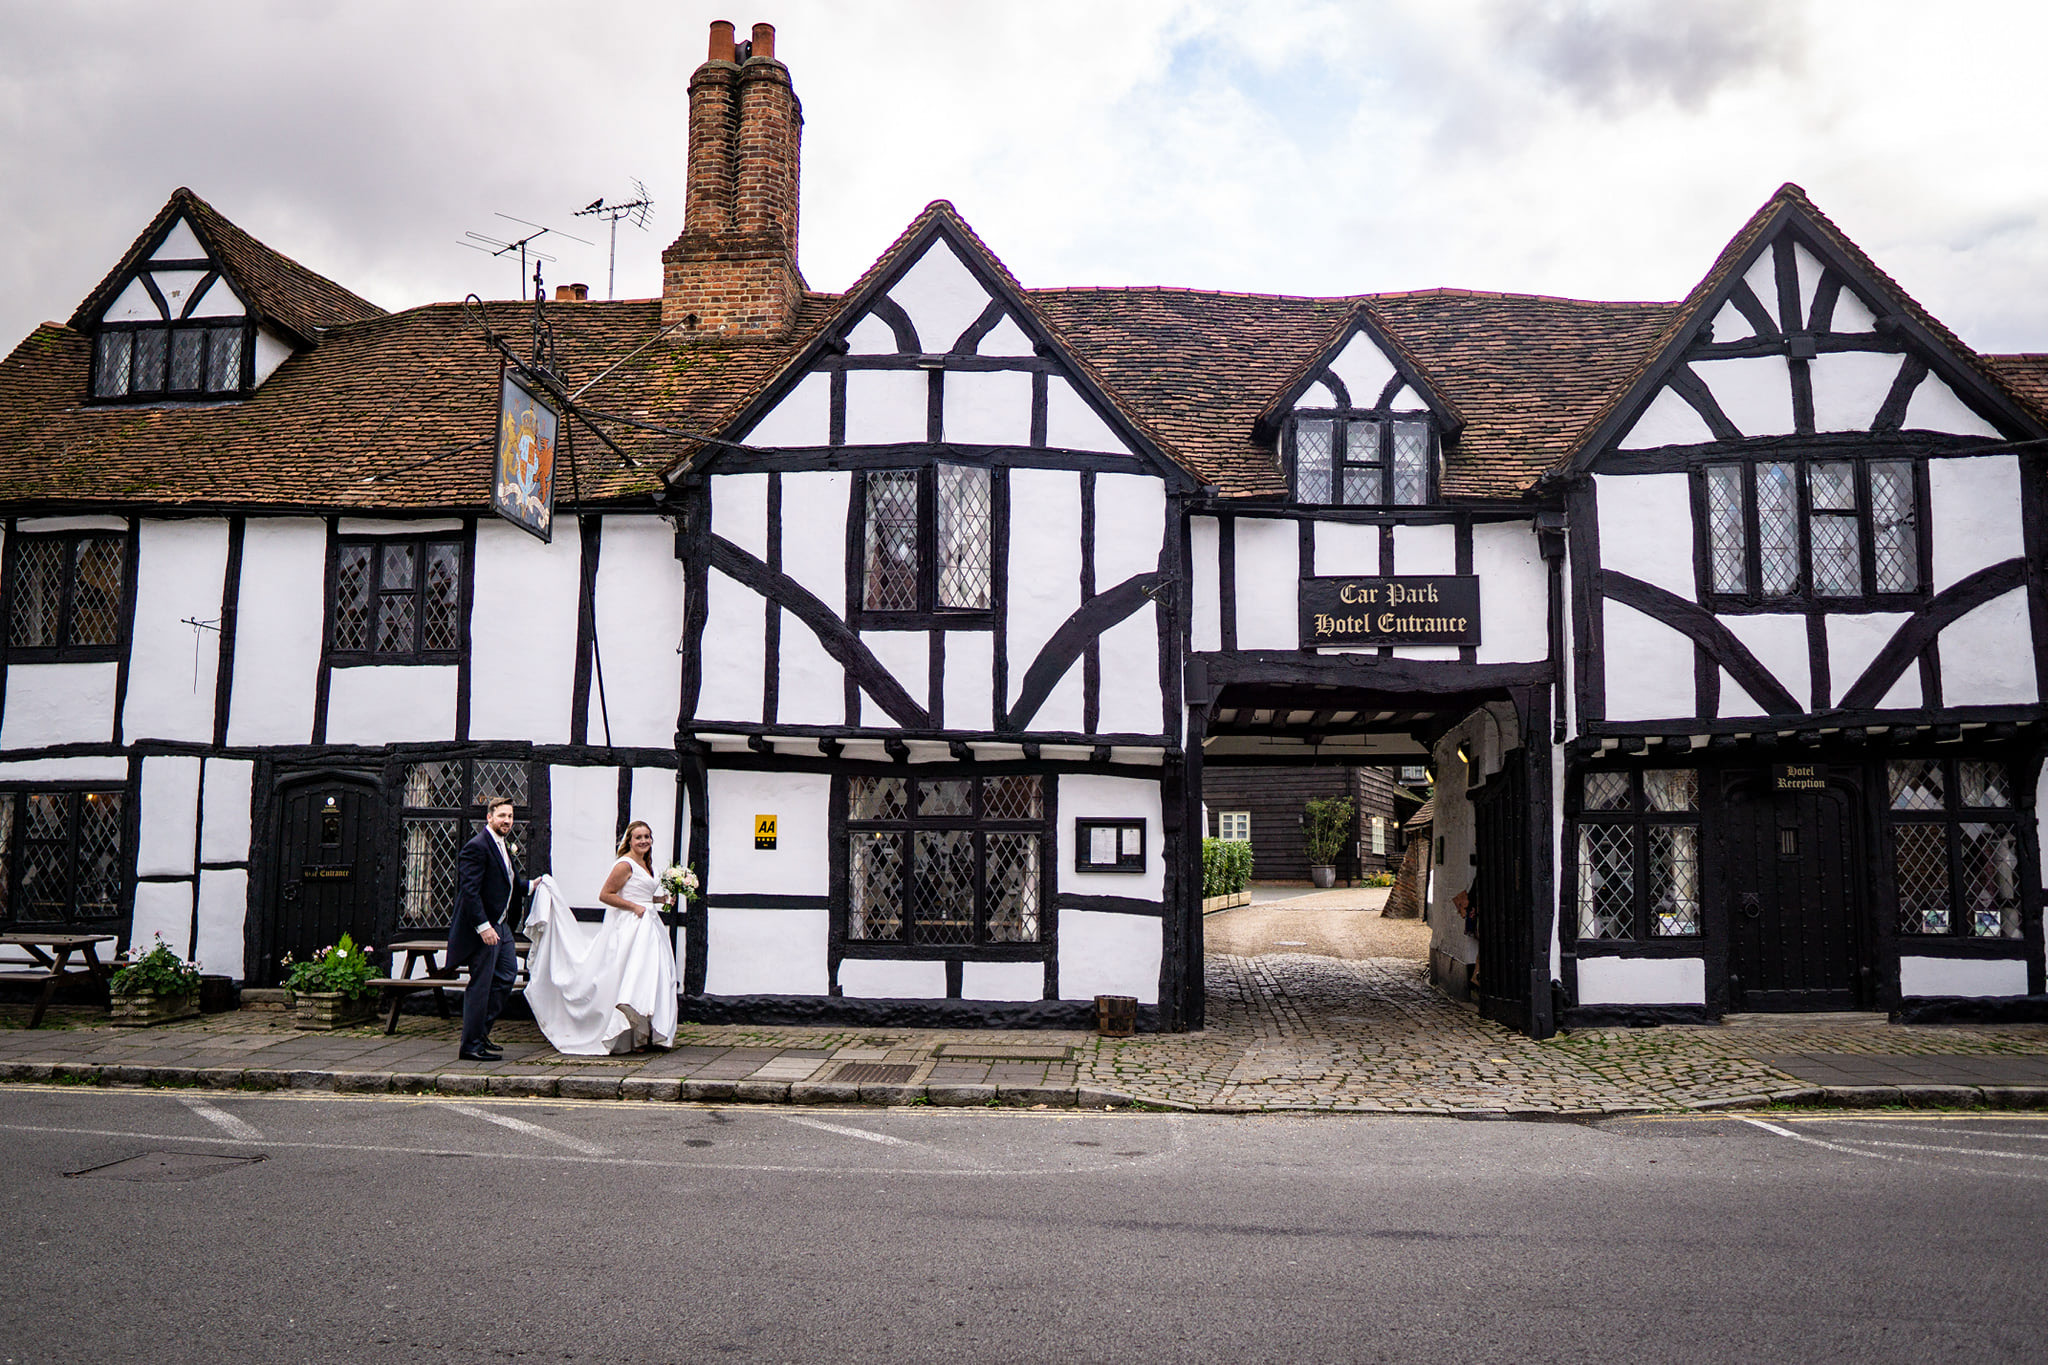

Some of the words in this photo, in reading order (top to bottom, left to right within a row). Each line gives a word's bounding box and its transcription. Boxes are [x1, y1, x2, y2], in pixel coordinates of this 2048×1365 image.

[1340, 584, 1379, 604] Car
[1385, 583, 1439, 607] Park
[1313, 613, 1371, 637] Hotel
[1377, 613, 1468, 633] Entrance
[1786, 765, 1815, 777] Hotel
[1777, 777, 1825, 790] Reception
[758, 821, 775, 833] AA
